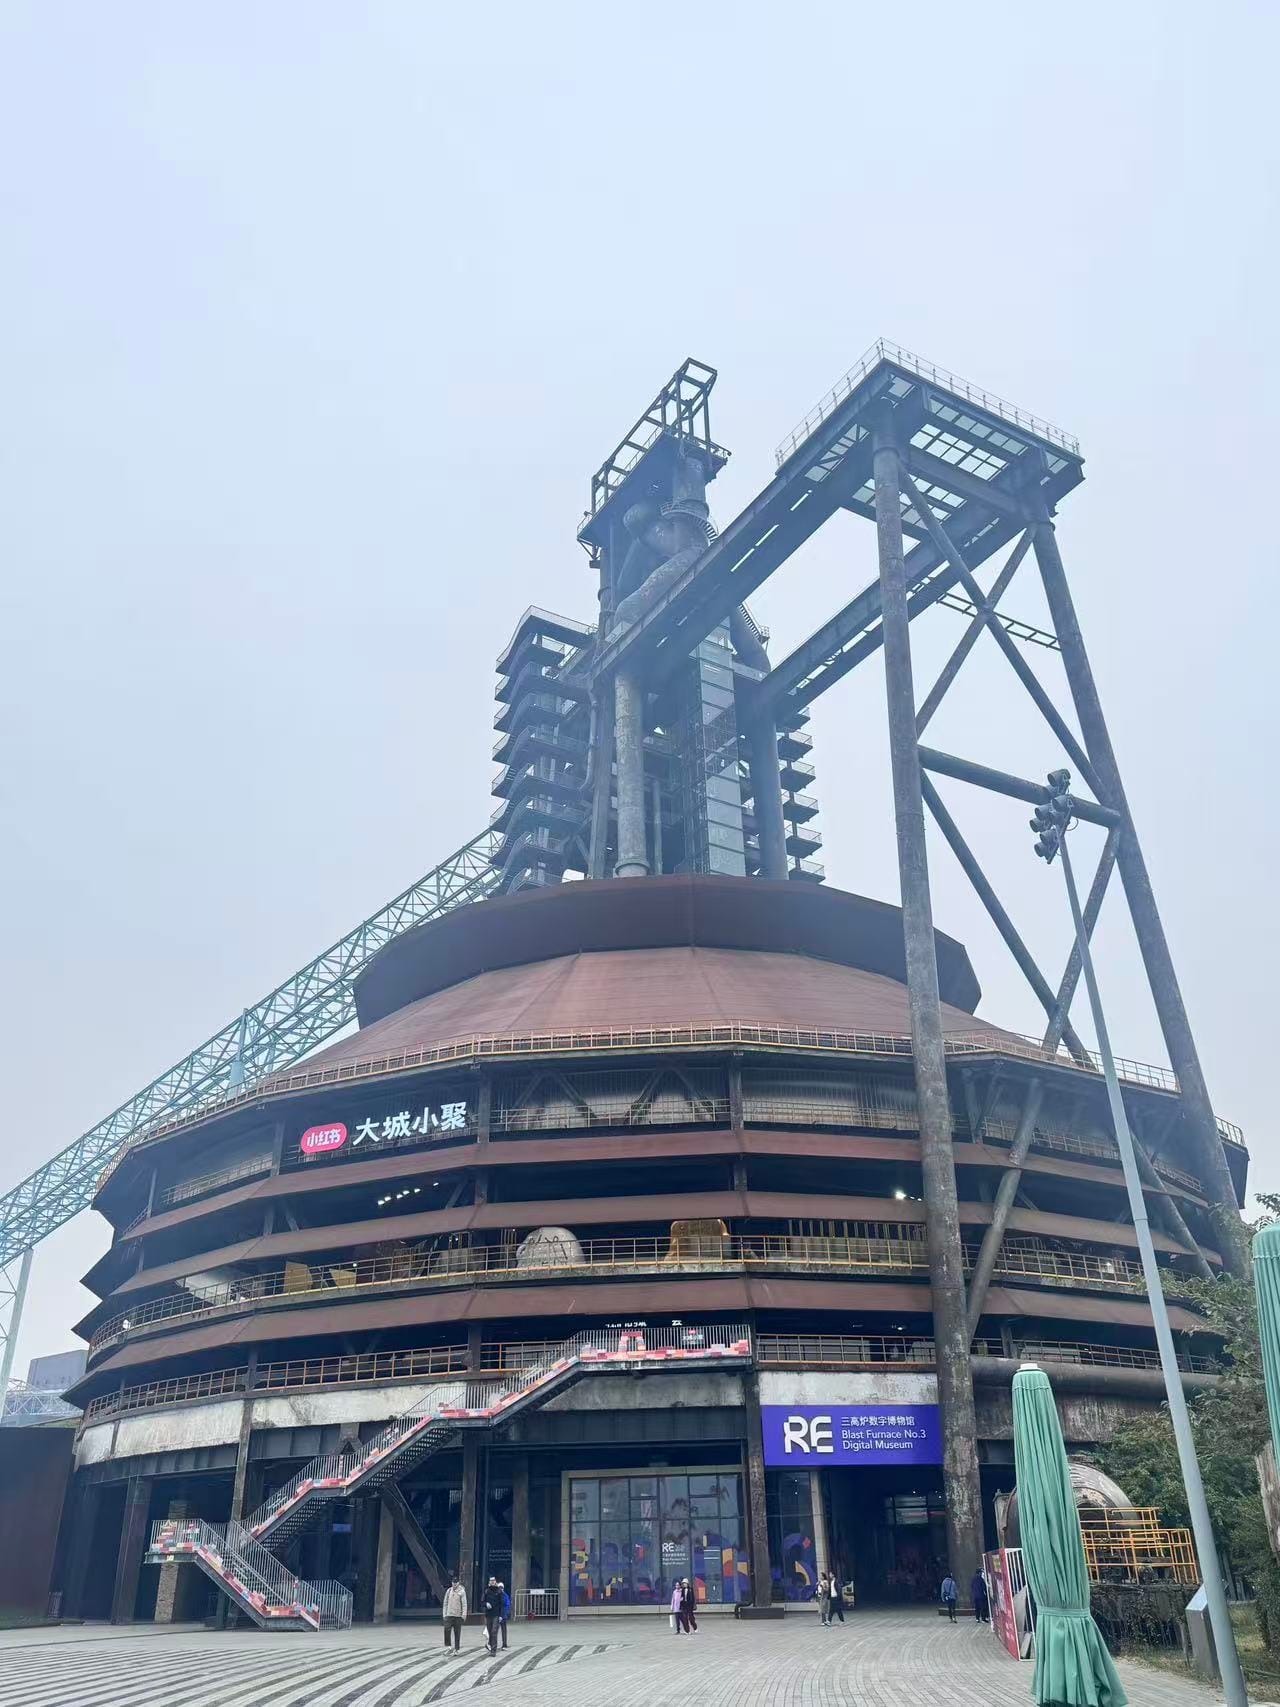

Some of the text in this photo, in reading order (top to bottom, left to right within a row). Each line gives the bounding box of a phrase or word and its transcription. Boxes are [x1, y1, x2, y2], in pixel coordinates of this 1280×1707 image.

[306, 1101, 467, 1148] 小红书 大城小聚
[841, 1416, 915, 1426] 三高炉数字博物馆
[783, 1416, 834, 1453] RE
[842, 1430, 926, 1439] Blast Furnace No.3
[843, 1439, 913, 1451] Digital Museum
[662, 1542, 675, 1552] RE
